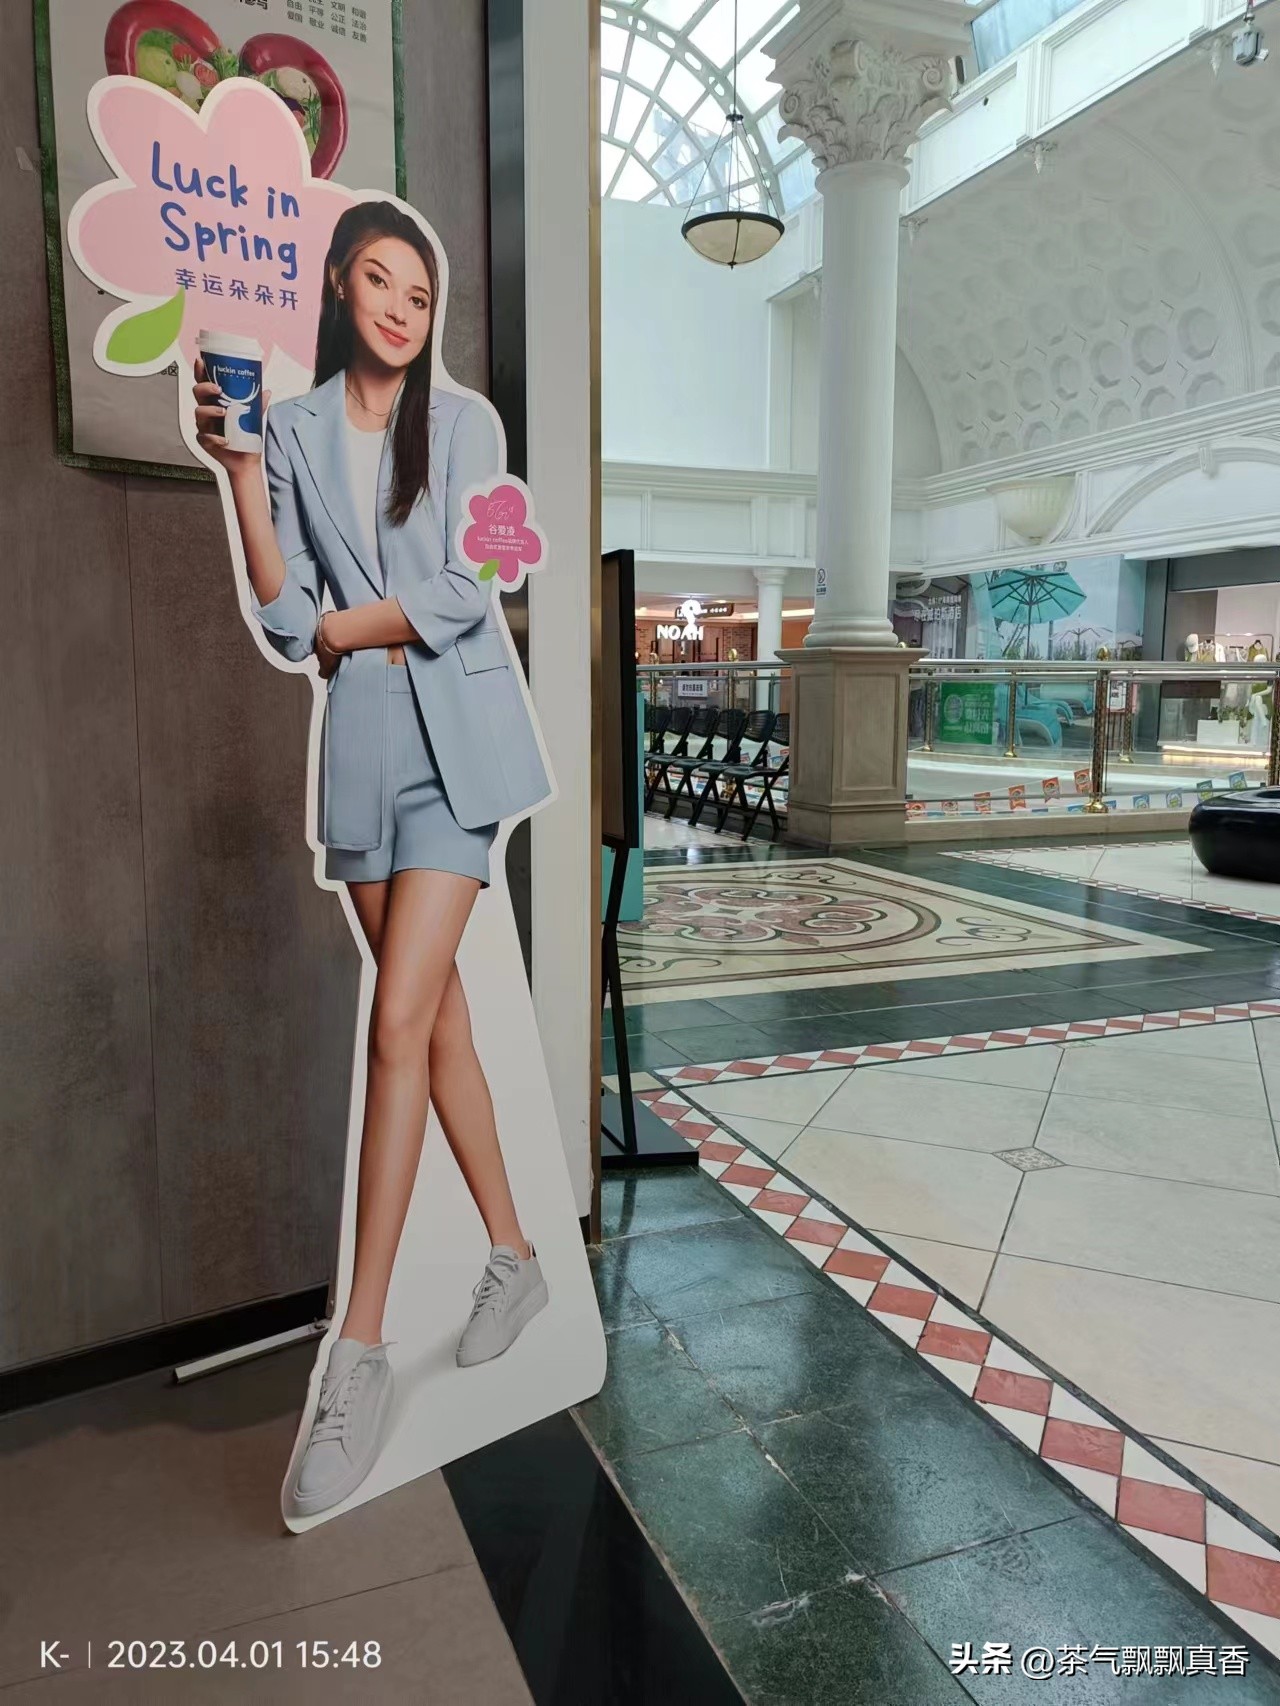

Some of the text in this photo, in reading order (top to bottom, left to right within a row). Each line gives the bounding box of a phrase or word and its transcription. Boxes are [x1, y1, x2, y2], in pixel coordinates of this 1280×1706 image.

[331, 1, 346, 12] 文明
[287, 11, 303, 23] 爱国
[309, 17, 325, 29] 敬业
[331, 12, 345, 24] 公正
[352, 18, 367, 31] 法治
[152, 141, 300, 219] Luck in
[160, 201, 298, 281] Spring
[175, 268, 298, 310] 幸运朵朵开
[217, 364, 236, 375] luckin
[237, 369, 255, 377] coffee
[656, 624, 704, 641] NOAH
